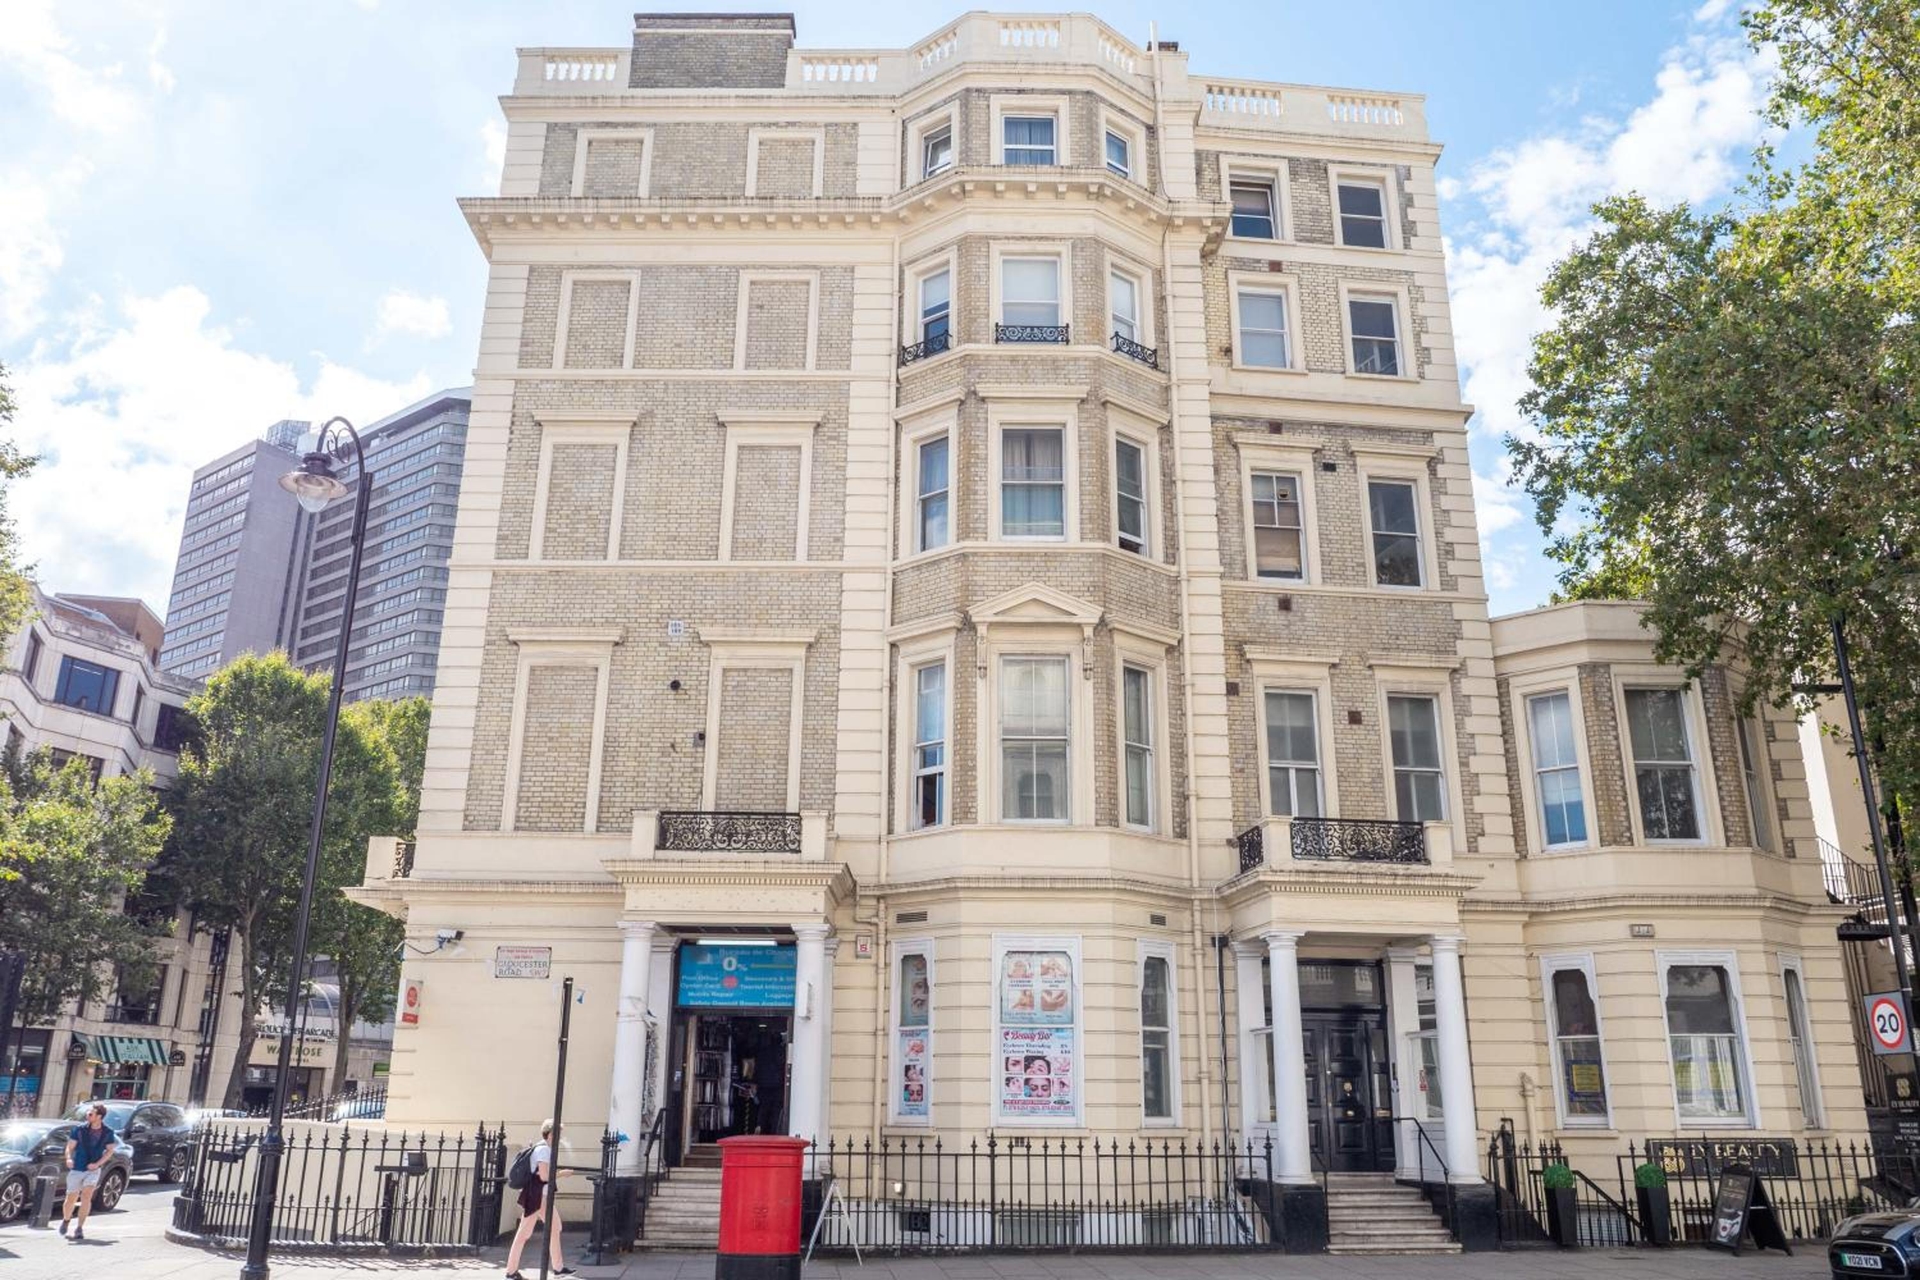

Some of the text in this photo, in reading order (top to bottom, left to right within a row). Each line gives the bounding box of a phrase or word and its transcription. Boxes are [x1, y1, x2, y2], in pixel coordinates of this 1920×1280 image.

[498, 960, 549, 969] GLOUCESTER
[499, 968, 521, 976] ROAD
[1877, 1013, 1899, 1033] 20
[267, 1044, 323, 1057] WROSE
[1863, 1255, 1879, 1267] VCN
